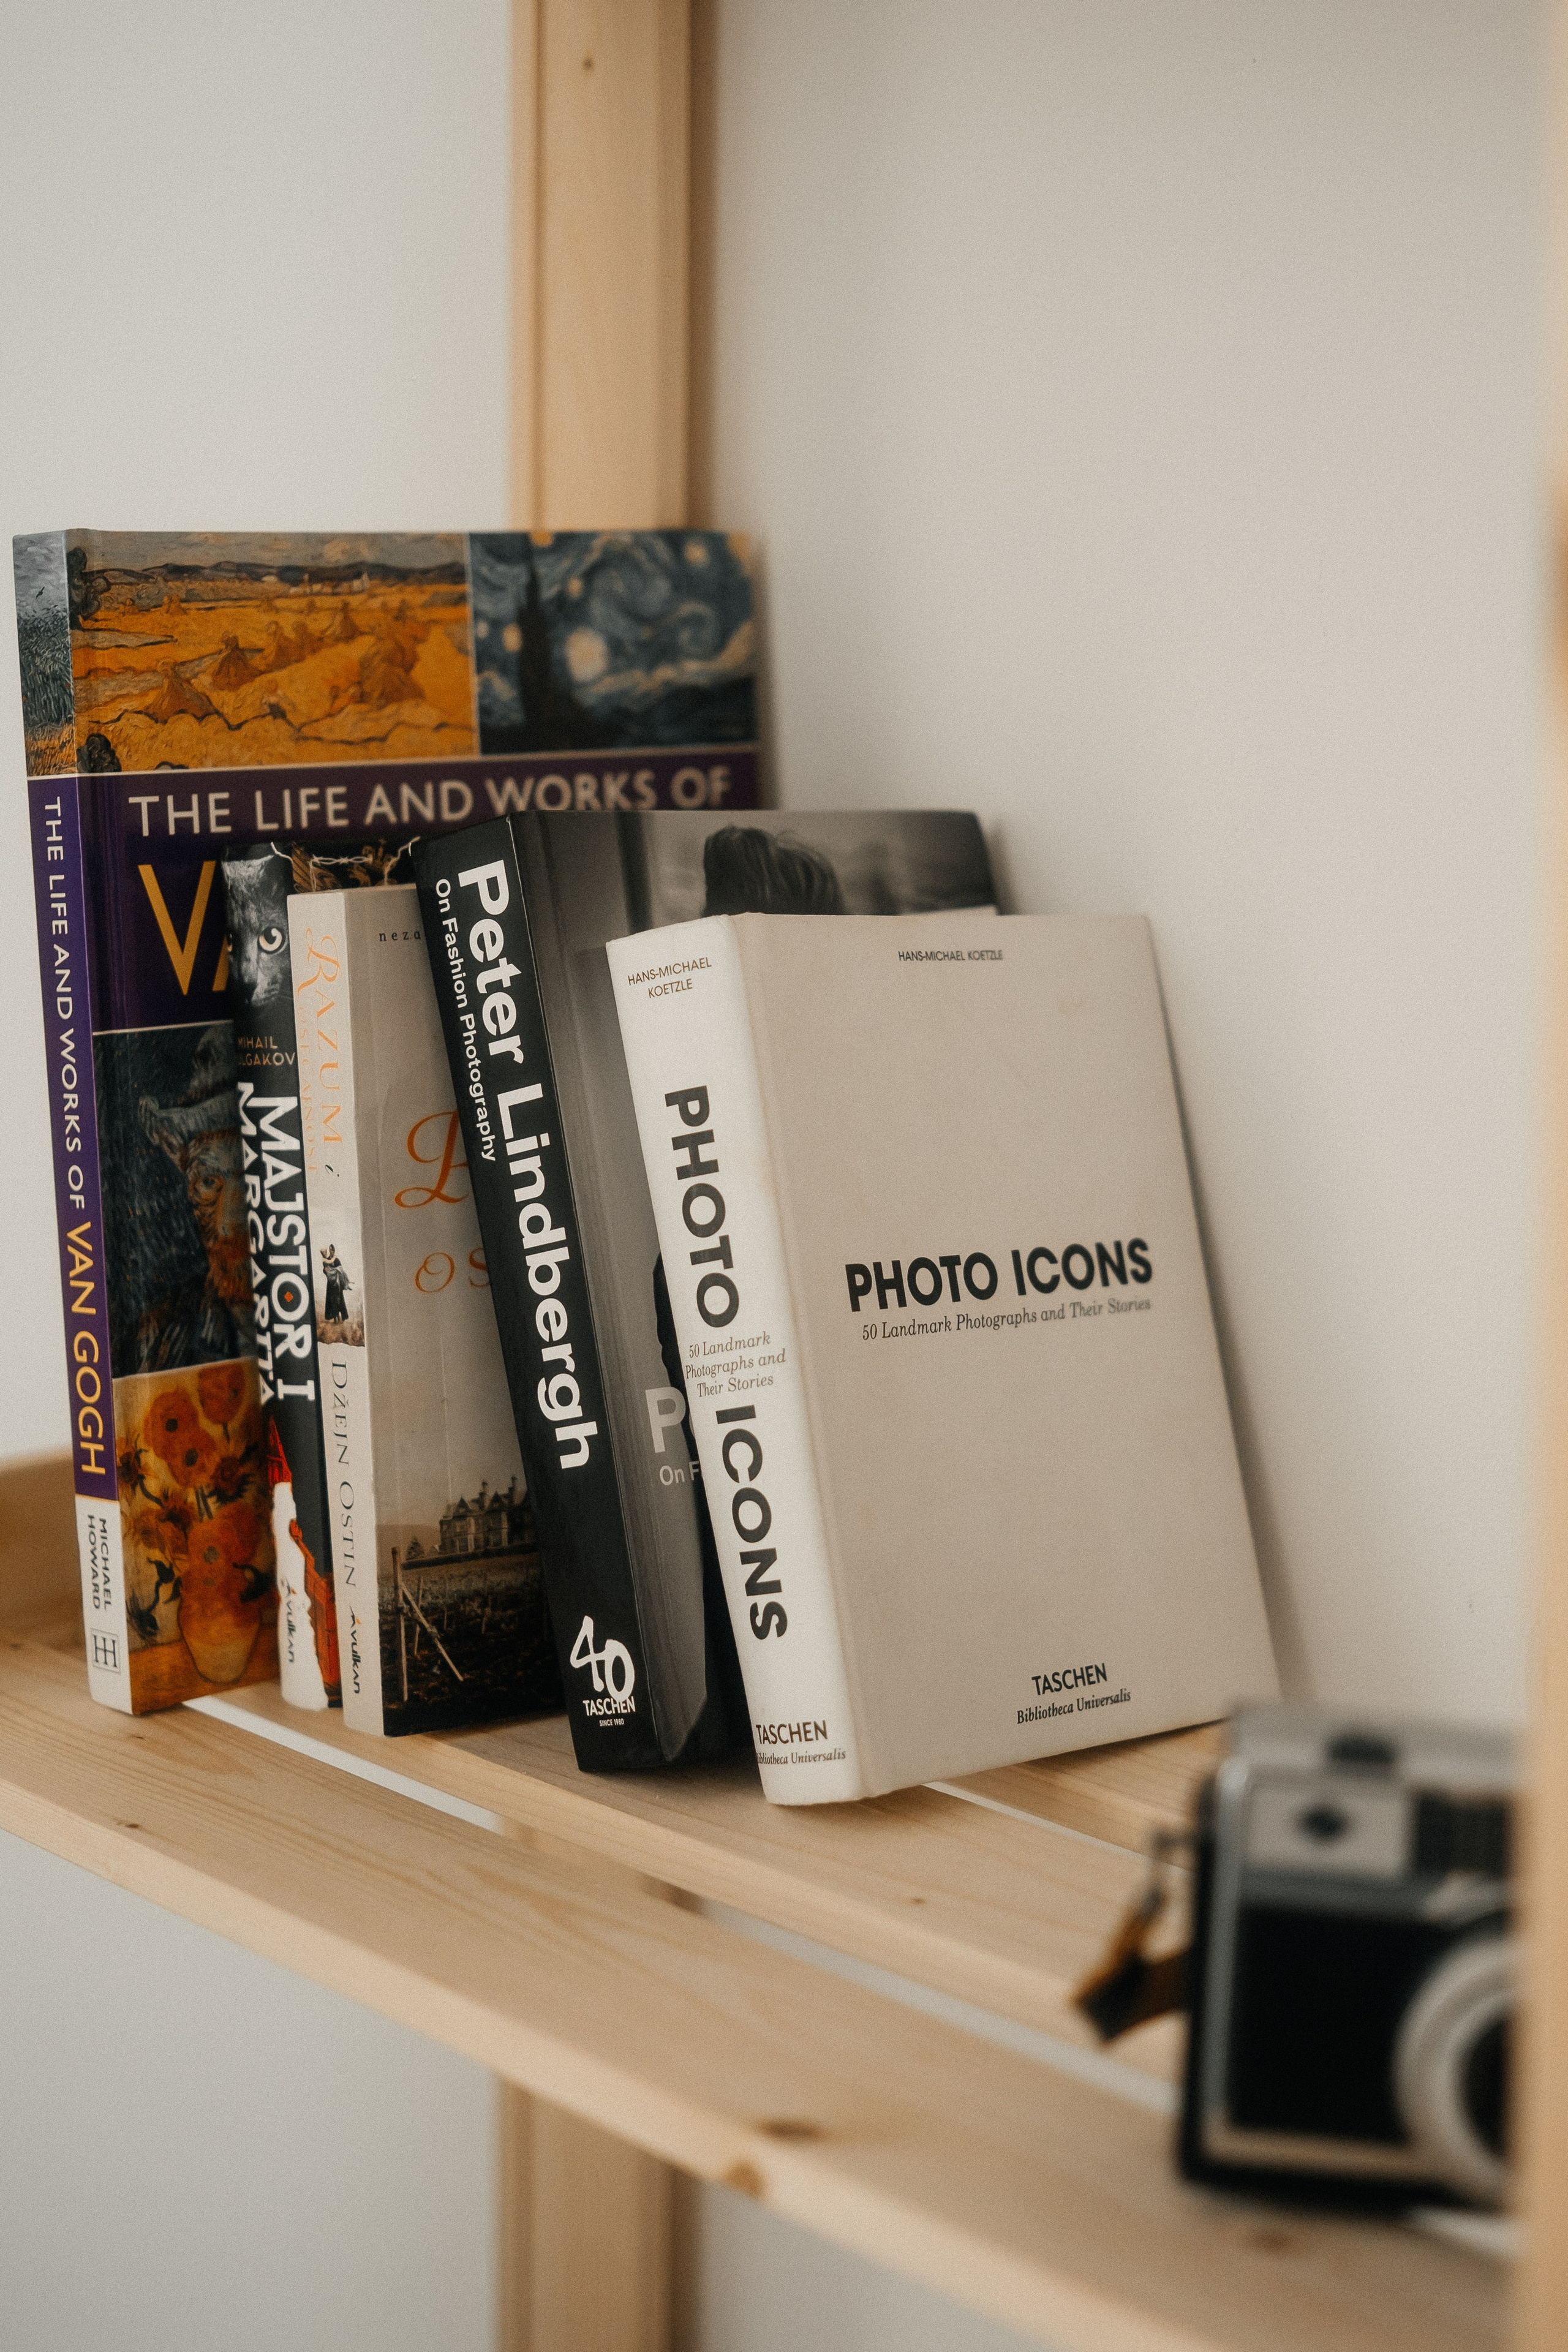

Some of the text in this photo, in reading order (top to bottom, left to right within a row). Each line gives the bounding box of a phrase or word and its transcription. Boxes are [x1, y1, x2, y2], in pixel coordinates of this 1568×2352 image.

[129, 766, 731, 837] THE LIFE AND WORKS OF
[138, 860, 229, 995] V
[898, 949, 1003, 962] HANS-MICHAEL KOETZLE
[628, 957, 712, 998] HANS-MICHAEL KOETZLE
[296, 927, 342, 1143] RAZUM
[435, 879, 496, 1161] On Fashion Photography
[45, 796, 106, 1476] THE LIFE AND WORKS OF VAN GOGH
[458, 859, 598, 1469] Peter Lindbergh
[246, 1096, 315, 1401] MAJSTOR I
[845, 1237, 1153, 1313] PHOTO ICONS
[689, 1331, 771, 1359] 50 Landmark
[862, 1296, 1152, 1341] 50 Landmark Photographs and Their Stories
[664, 1085, 788, 1640] PHOTO ICONS
[685, 1348, 786, 1379] Photographs and
[697, 1373, 774, 1397] Their Stories
[331, 1360, 356, 1586] DŽEJN OSTIN
[660, 1465, 685, 1485] On
[88, 1514, 100, 1610] HOWARD
[99, 1518, 111, 1610] MICHAEL
[570, 1615, 635, 1702] 40
[1031, 1662, 1107, 1695] TASCHEN
[582, 1696, 636, 1716] TASCHEN
[599, 1717, 624, 1727] SINCE 1980
[756, 1720, 828, 1744] TASCHEN
[1017, 1687, 1131, 1724] Bibliotheca Universalis
[791, 1747, 846, 1764] Universalis
